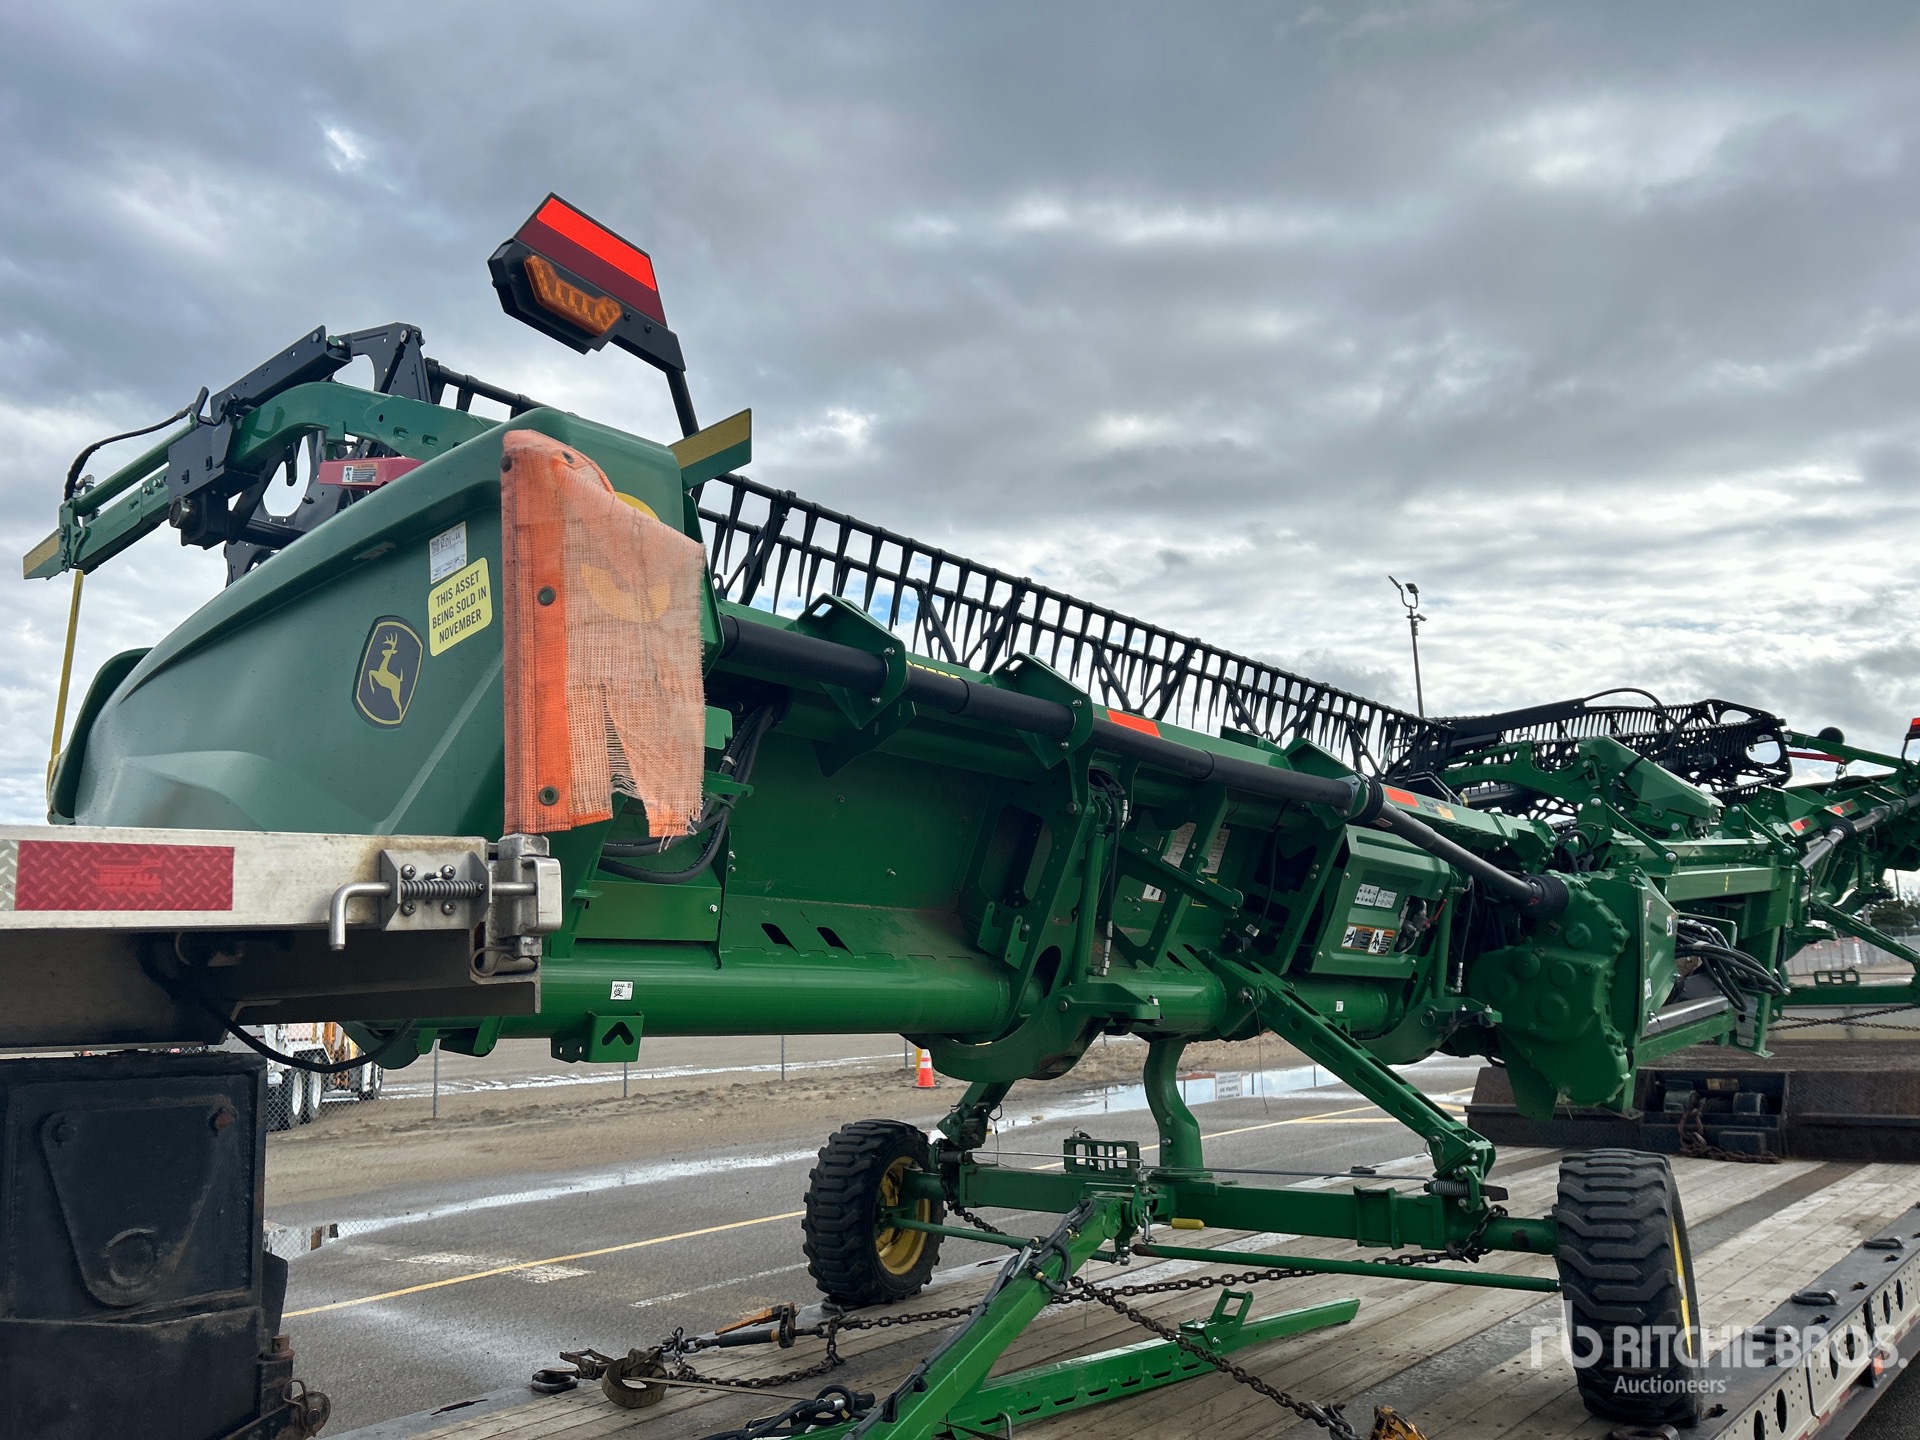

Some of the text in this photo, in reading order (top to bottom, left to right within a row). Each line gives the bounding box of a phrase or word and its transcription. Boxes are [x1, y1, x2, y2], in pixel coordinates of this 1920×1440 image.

[432, 585, 487, 629] BEING SOLD IN
[436, 588, 453, 608] THIS
[455, 570, 480, 597] ASSET
[439, 608, 482, 644] NOVEMBER
